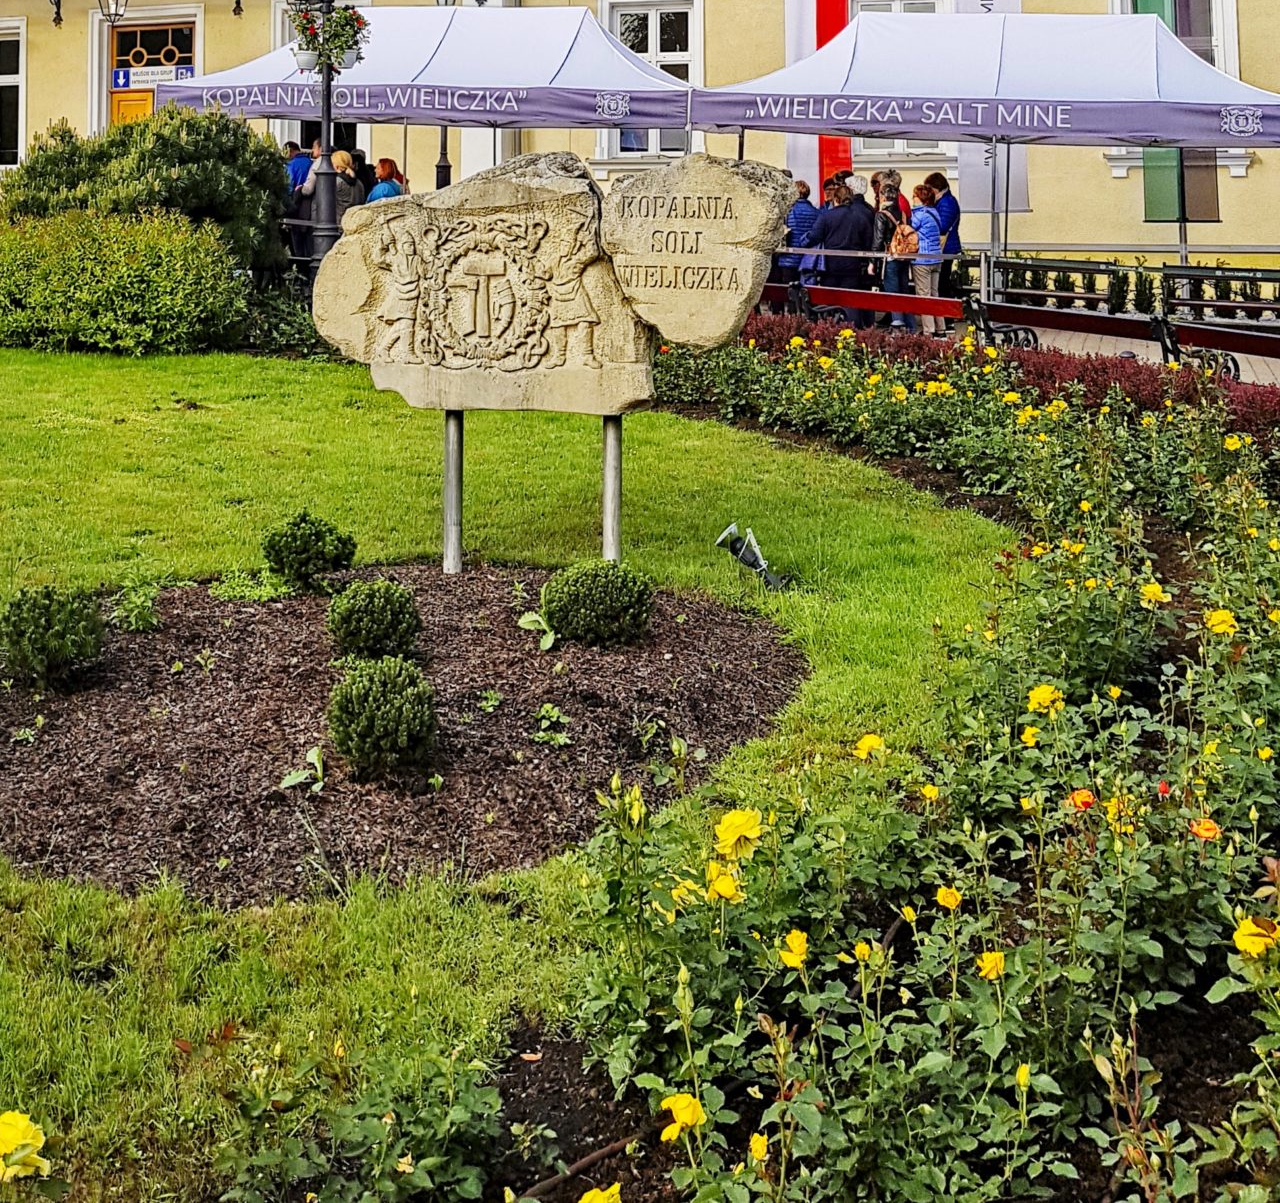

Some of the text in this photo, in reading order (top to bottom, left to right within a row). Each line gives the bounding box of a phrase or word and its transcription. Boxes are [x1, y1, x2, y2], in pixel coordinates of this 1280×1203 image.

[203, 86, 315, 107] KOPALNIA
[322, 87, 370, 108] OLI
[921, 101, 989, 126] SALT
[997, 104, 1072, 128] MINE
[620, 195, 738, 219] KOPALNIA
[651, 230, 703, 254] SOLI
[617, 265, 743, 291] WIELICZKA
